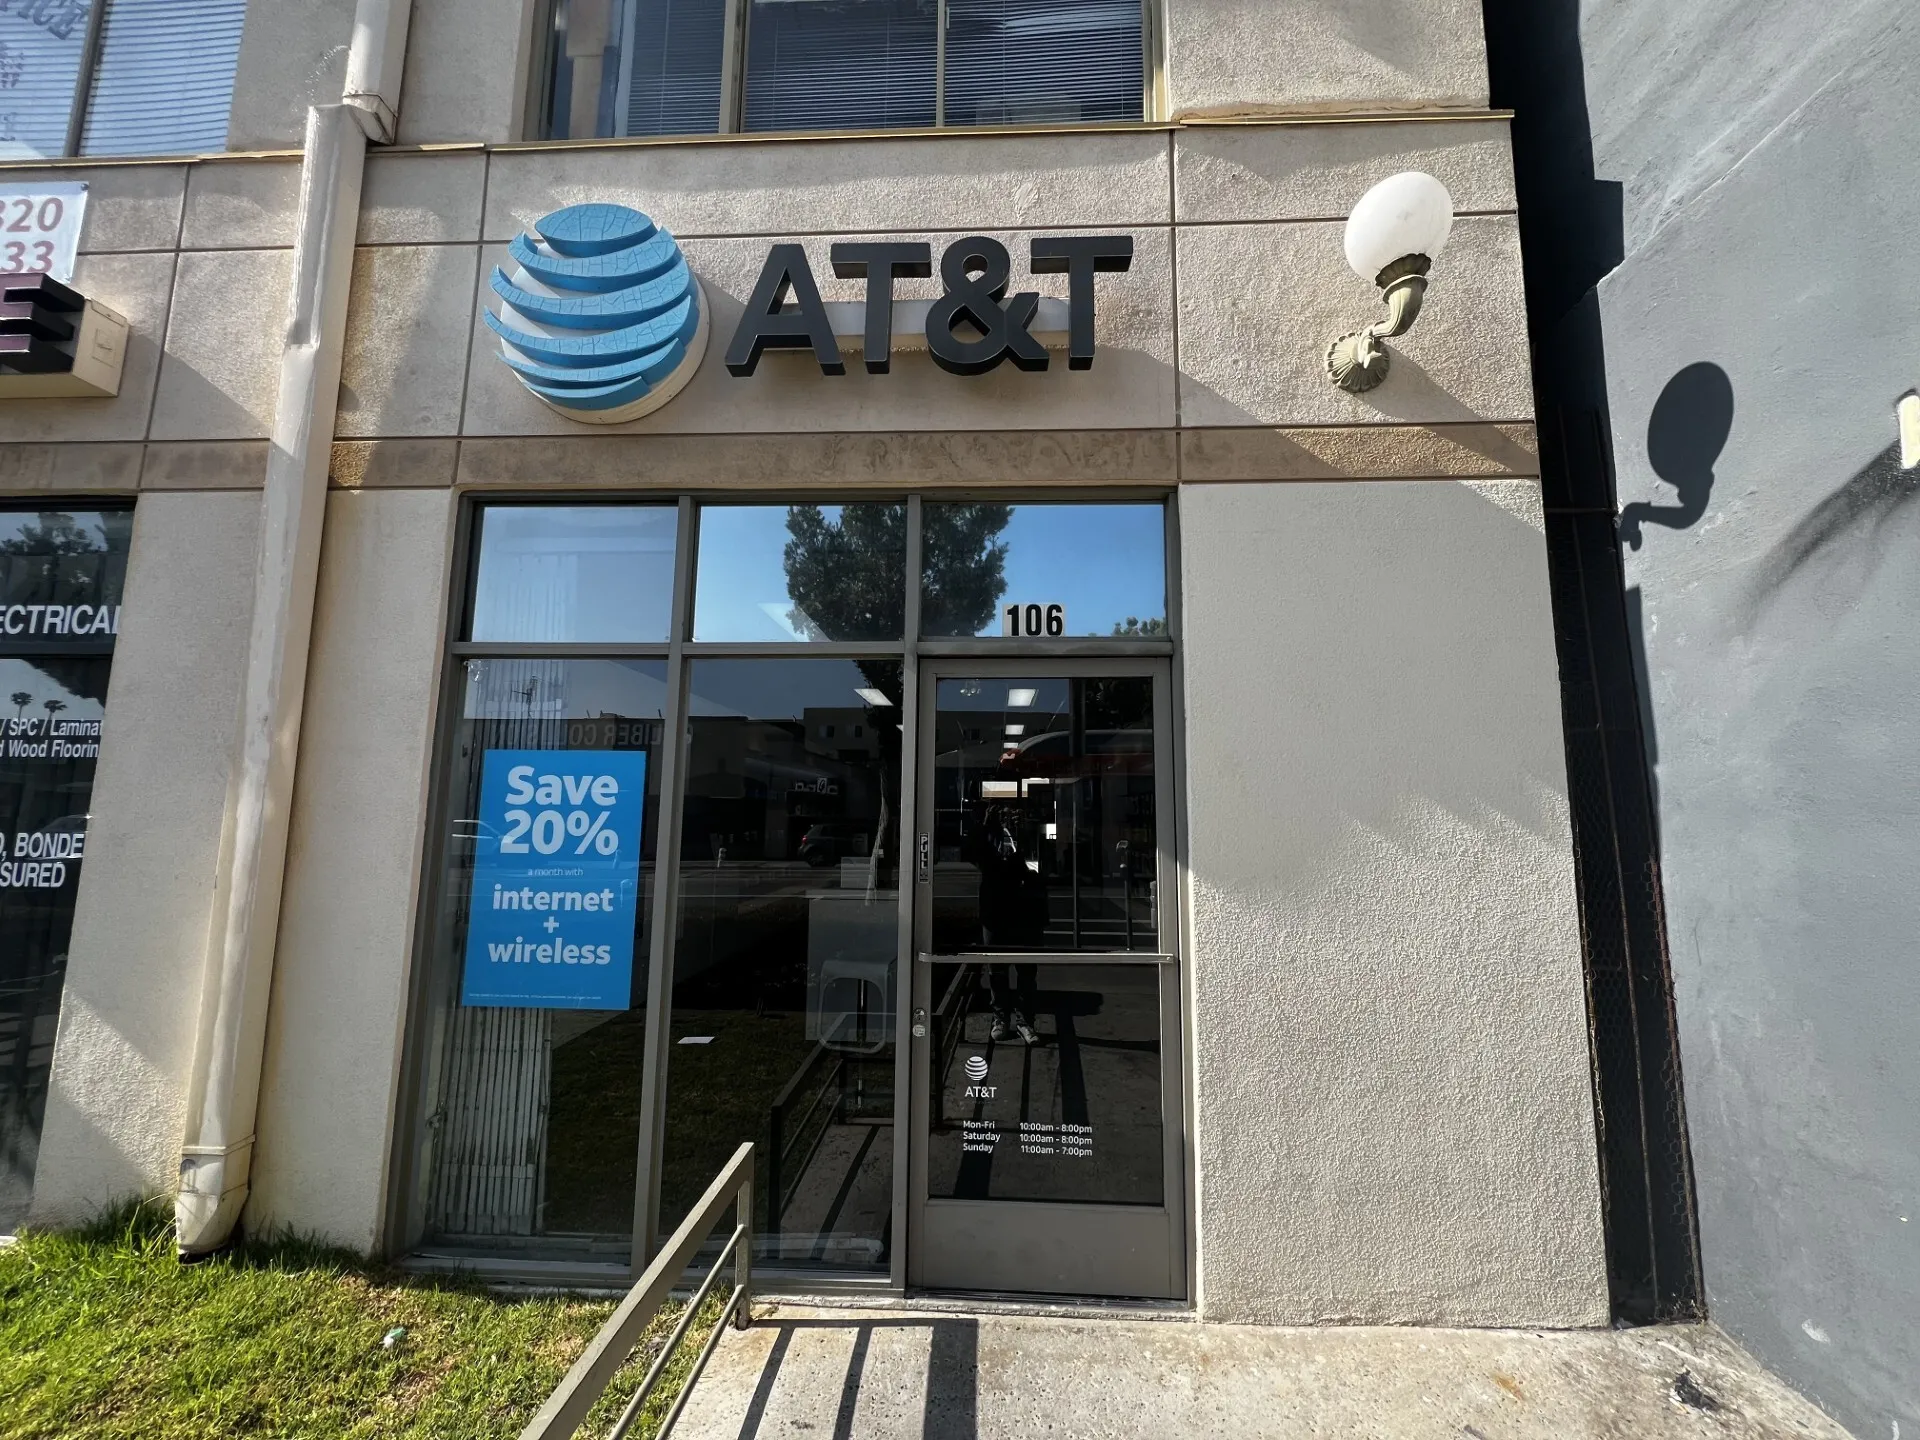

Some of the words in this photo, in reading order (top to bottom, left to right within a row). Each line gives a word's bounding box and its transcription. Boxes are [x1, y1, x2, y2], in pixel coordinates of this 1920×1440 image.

[0, 197, 64, 233] 20
[725, 235, 1134, 377] AT&T
[0, 604, 121, 634] CTRICA
[1006, 603, 1063, 637] 106
[8, 718, 38, 736] SPC
[9, 739, 48, 757] Wood
[51, 739, 99, 758] Floorin
[505, 765, 619, 806] Save
[14, 832, 84, 858] BONDE
[500, 809, 619, 856] 20%
[920, 836, 928, 869] PULL
[0, 861, 66, 888] SURED
[534, 868, 563, 876] month
[564, 867, 584, 876] with
[492, 883, 615, 912] internet
[543, 915, 560, 934] +
[487, 935, 611, 965] wireless
[964, 1086, 997, 1098] AT&T
[963, 1120, 995, 1129] Mon-Fri
[1020, 1122, 1054, 1132] 10:00am
[1061, 1124, 1093, 1134] 8:00pm
[963, 1131, 1001, 1142] Saturday
[1020, 1133, 1054, 1143] 10:00am
[1061, 1135, 1093, 1146] 8:00pm
[963, 1142, 994, 1153] Sunday
[1021, 1145, 1054, 1154] 11:00am
[1061, 1147, 1093, 1157] 7:00pm
